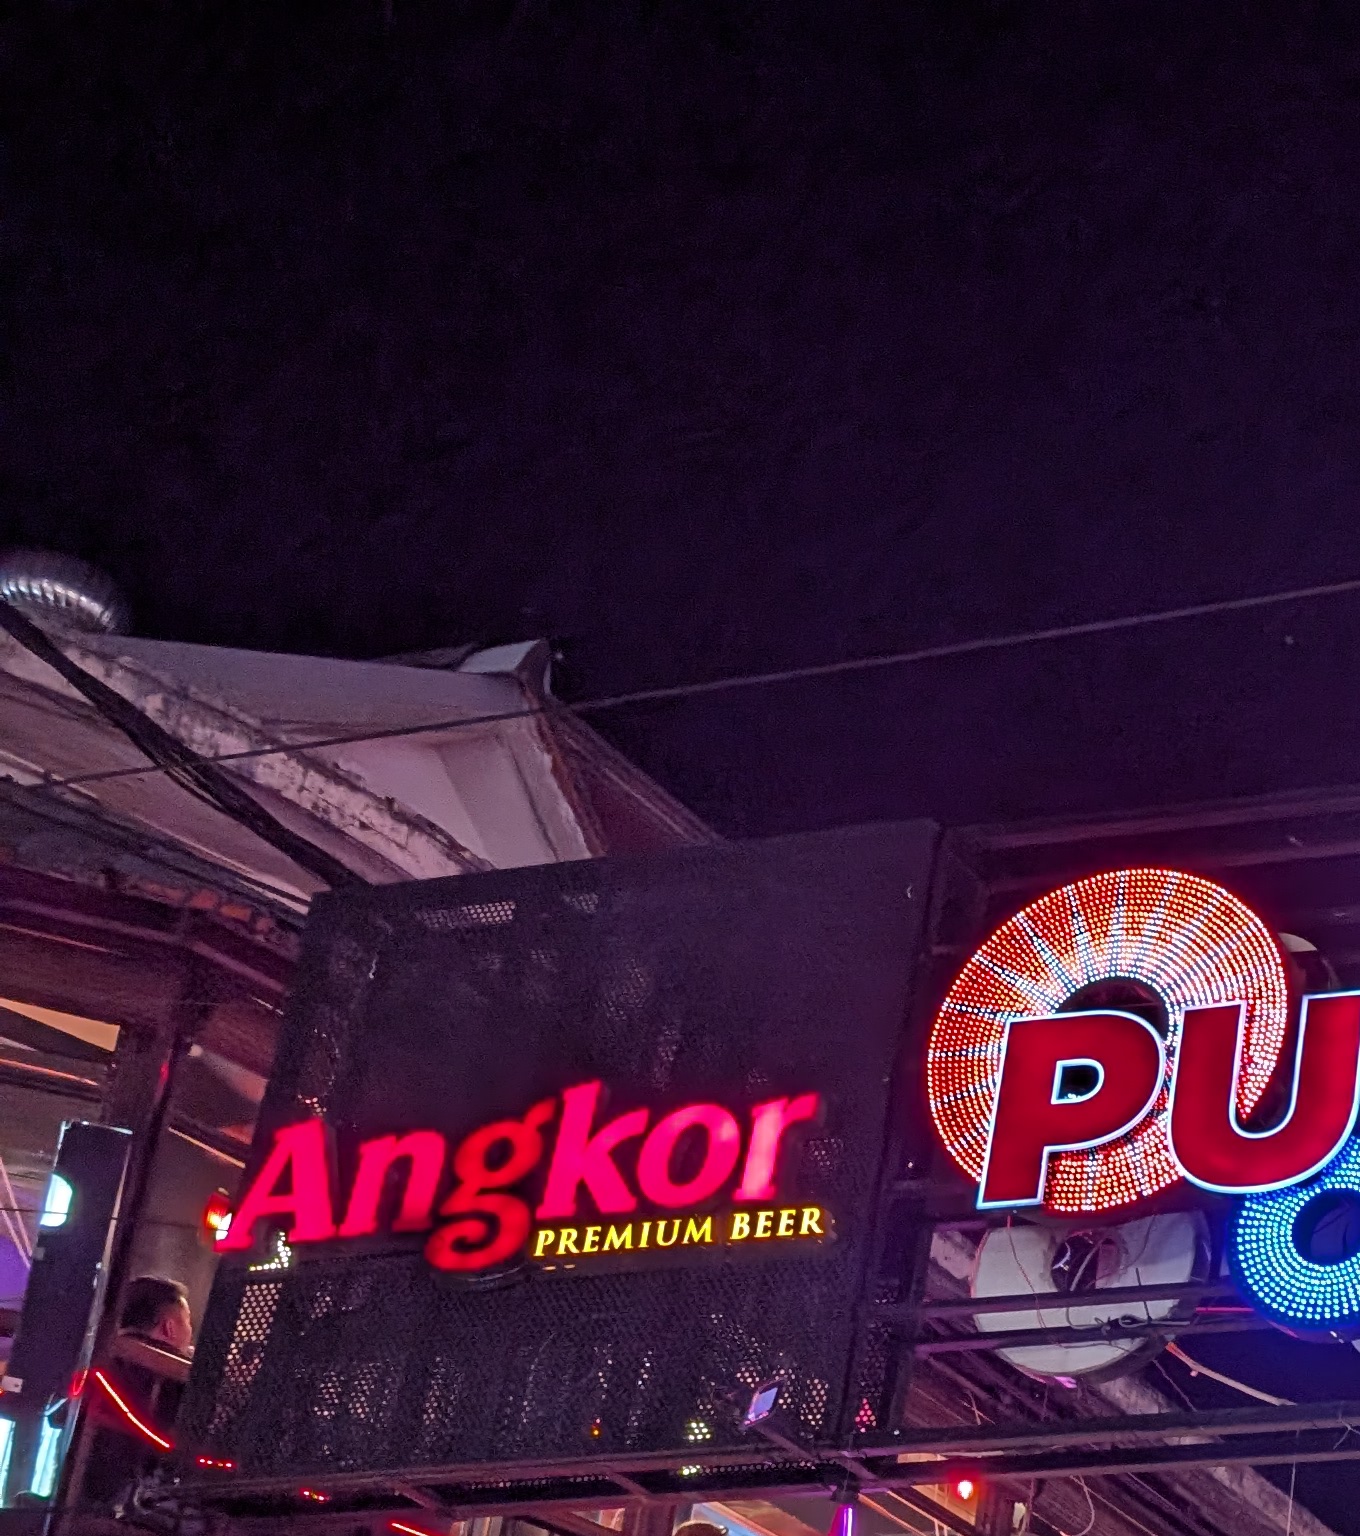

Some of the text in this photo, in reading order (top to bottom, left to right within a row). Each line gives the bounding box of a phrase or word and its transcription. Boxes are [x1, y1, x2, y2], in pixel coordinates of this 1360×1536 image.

[211, 1079, 820, 1272] Angkor
[532, 1207, 825, 1259] PREMIUM BEER
